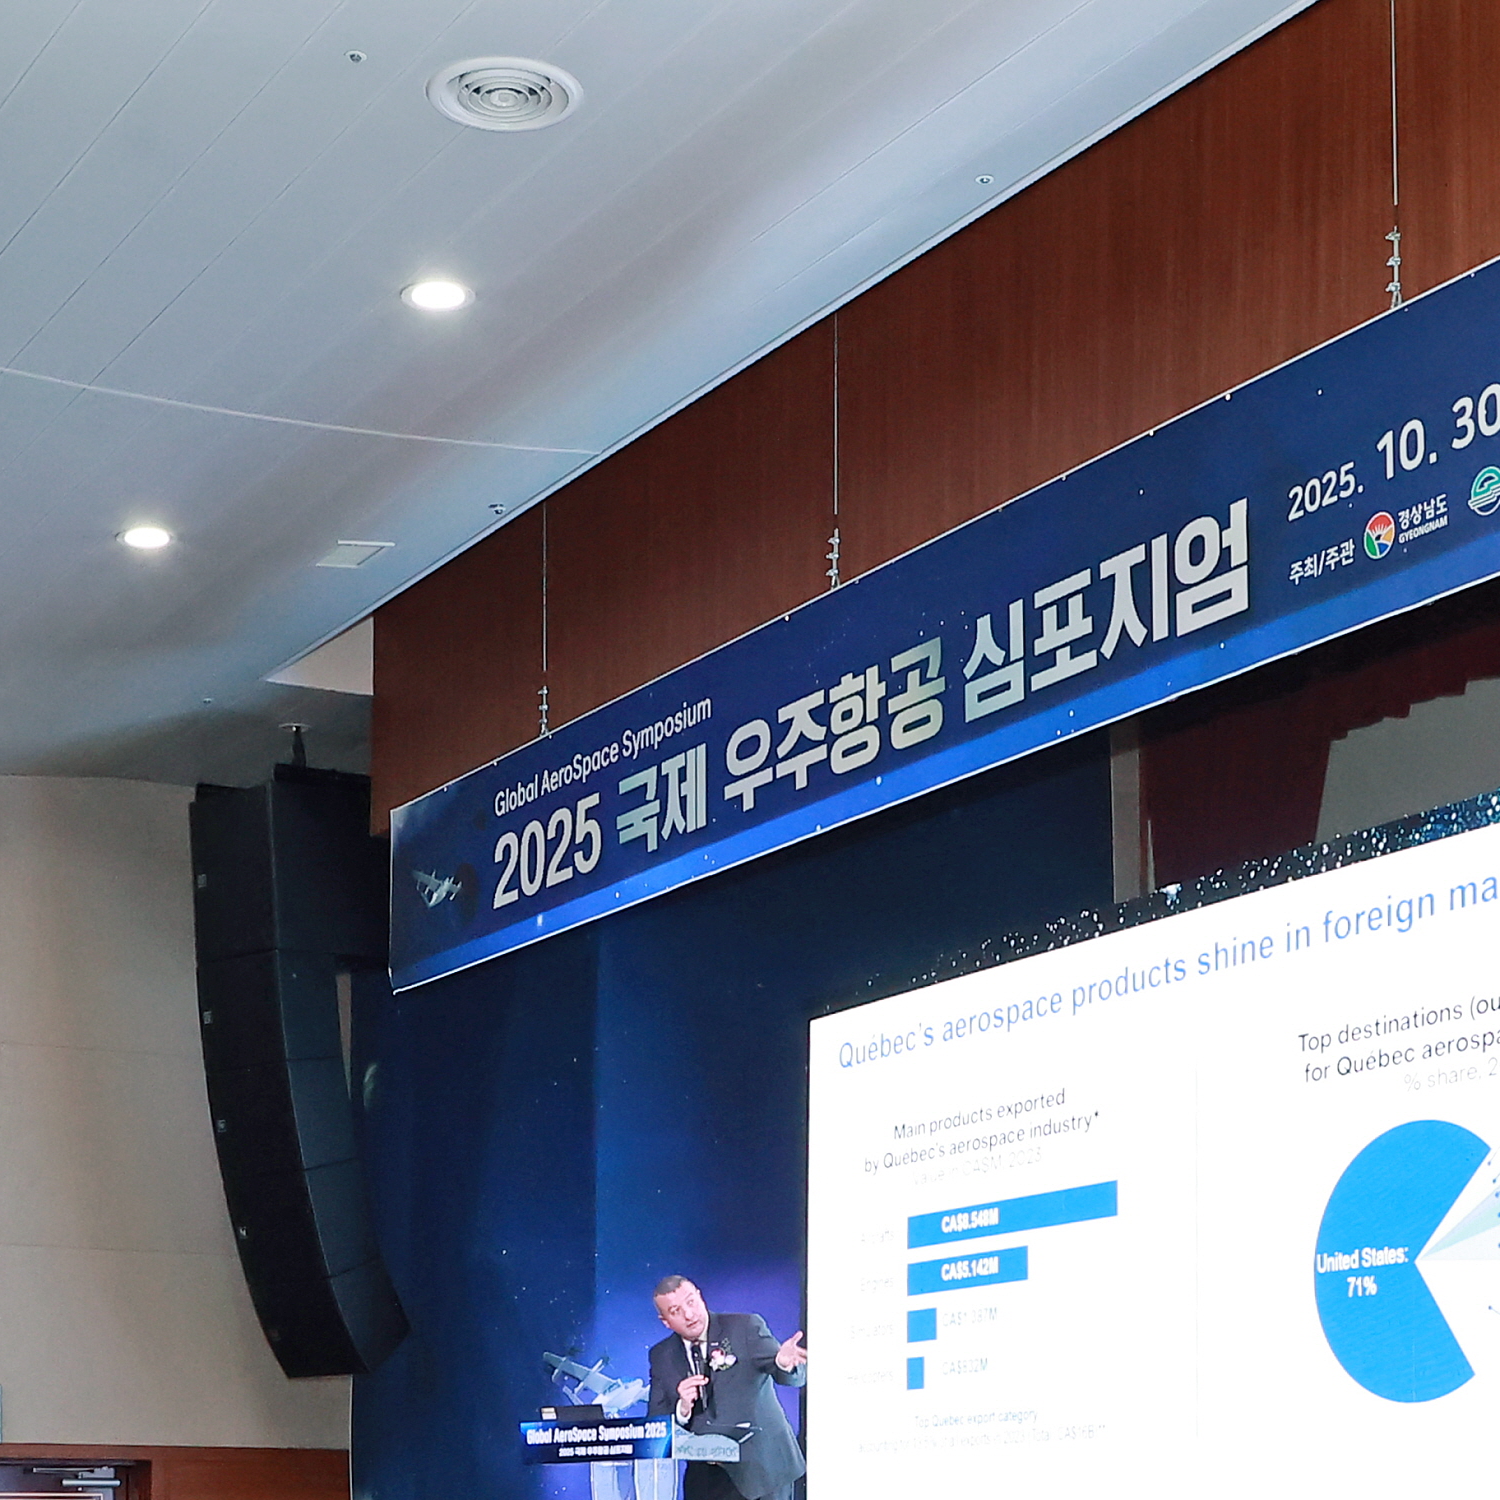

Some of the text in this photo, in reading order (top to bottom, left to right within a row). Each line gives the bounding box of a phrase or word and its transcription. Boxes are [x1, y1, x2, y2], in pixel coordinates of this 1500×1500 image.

[1287, 462, 1364, 521] 2025.
[1376, 419, 1437, 480] 10.
[1289, 494, 1448, 585] 주최/주관 경상남도
[1398, 515, 1448, 544] GYEONGNAM
[492, 497, 1250, 910] 2025 국제 우주항공 심포지엄
[494, 695, 712, 817] Global AeroSpace Symposium
[837, 1022, 936, 1071] Québec's
[941, 986, 1064, 1053] aerospace
[1070, 951, 1189, 1021] products
[1195, 930, 1276, 978] shine
[1286, 917, 1312, 956] in
[1321, 888, 1438, 948] foreign
[1298, 1032, 1332, 1055] Top
[1337, 1004, 1463, 1044] destinations
[1305, 1062, 1330, 1083] for
[1336, 1046, 1415, 1076] Québec
[893, 1087, 1065, 1140] Main products exported
[864, 1157, 879, 1175] by
[949, 1124, 1025, 1157] aerospace
[1316, 1245, 1409, 1274] United States:
[1346, 1276, 1378, 1299] 71%
[526, 1422, 668, 1445] Global AeroSpace Symposium 2025
